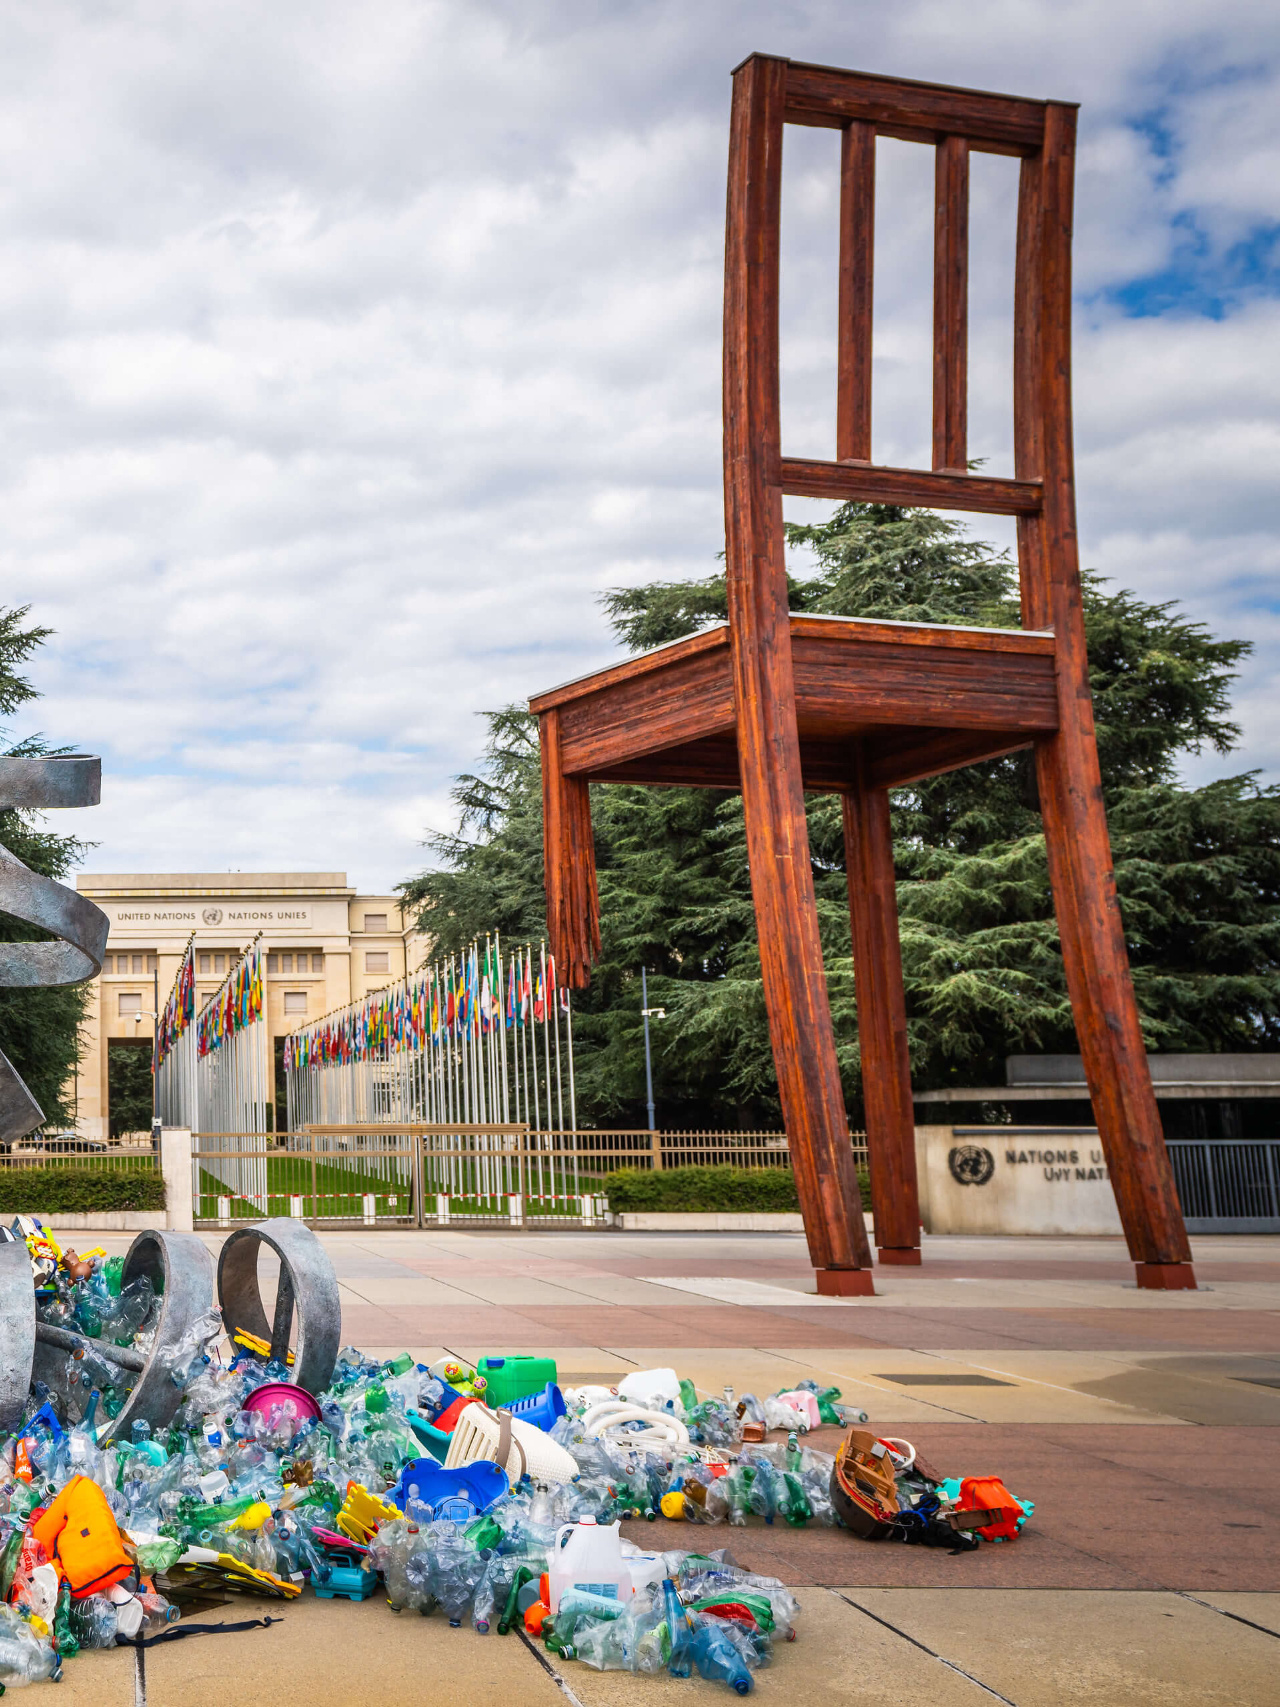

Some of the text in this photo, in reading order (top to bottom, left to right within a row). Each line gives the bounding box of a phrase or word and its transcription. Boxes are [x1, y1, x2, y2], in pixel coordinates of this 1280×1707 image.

[117, 911, 307, 921] UNITED NATIONS NATIONS UNIES
[1006, 1150, 1079, 1164] NATIONS
